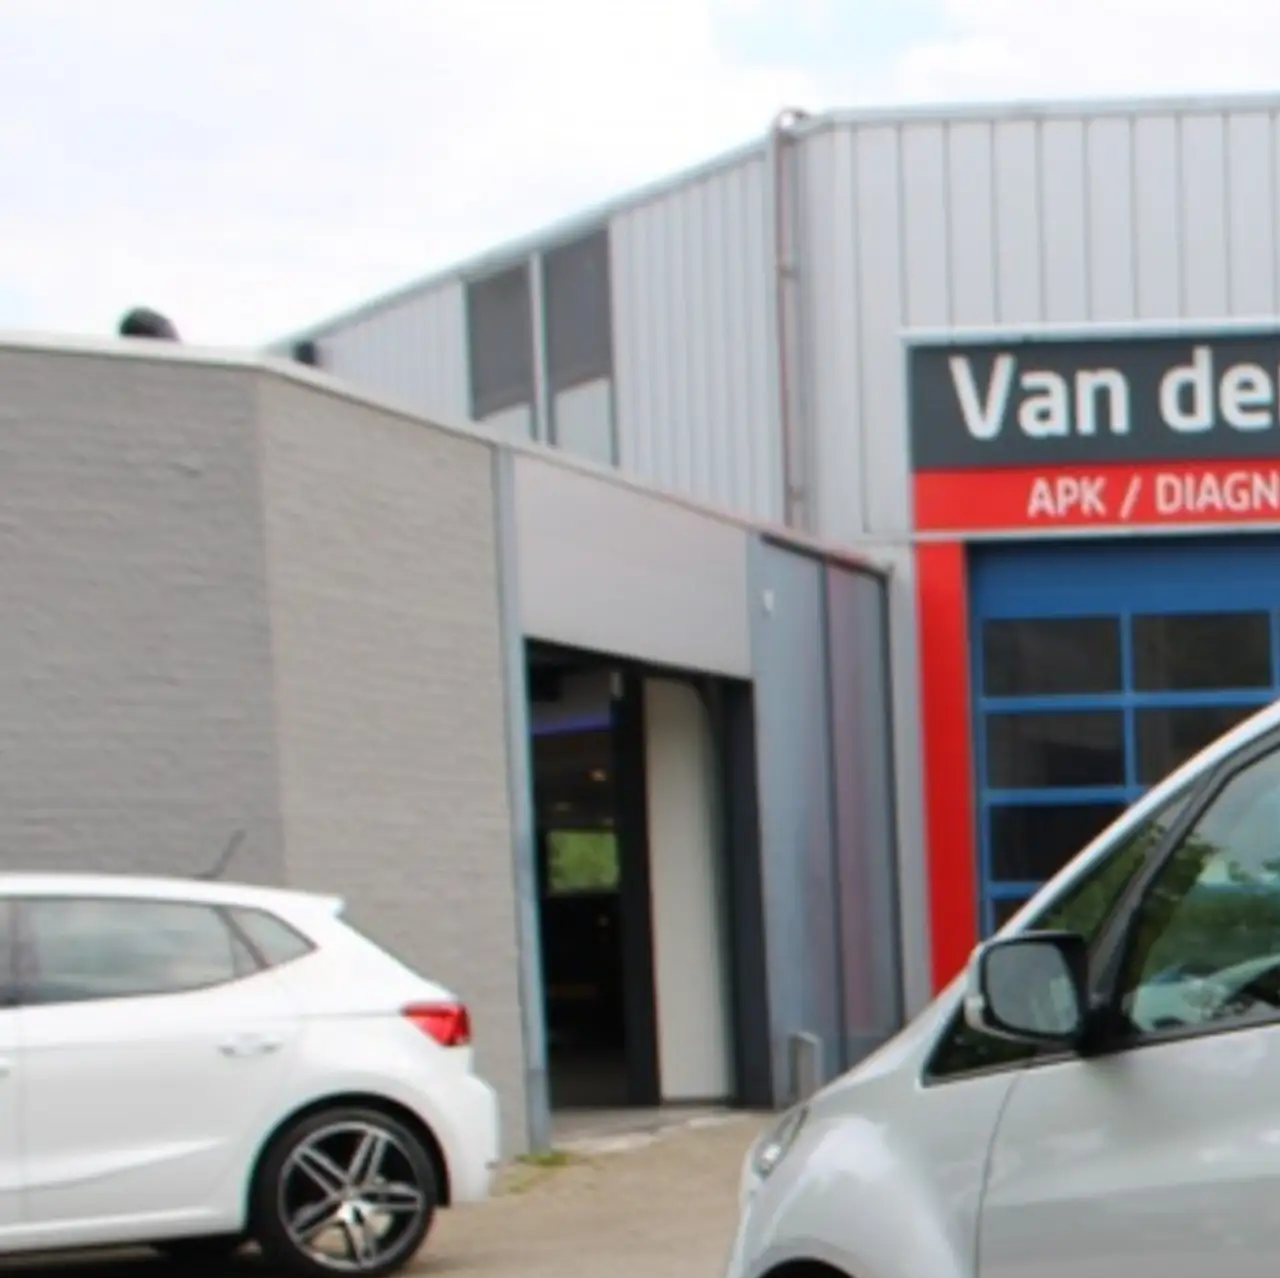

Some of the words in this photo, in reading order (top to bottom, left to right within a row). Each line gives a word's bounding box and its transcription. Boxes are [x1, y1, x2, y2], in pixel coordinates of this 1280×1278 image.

[950, 353, 1132, 438] Van
[1027, 475, 1107, 517] APK
[1119, 475, 1141, 519] /
